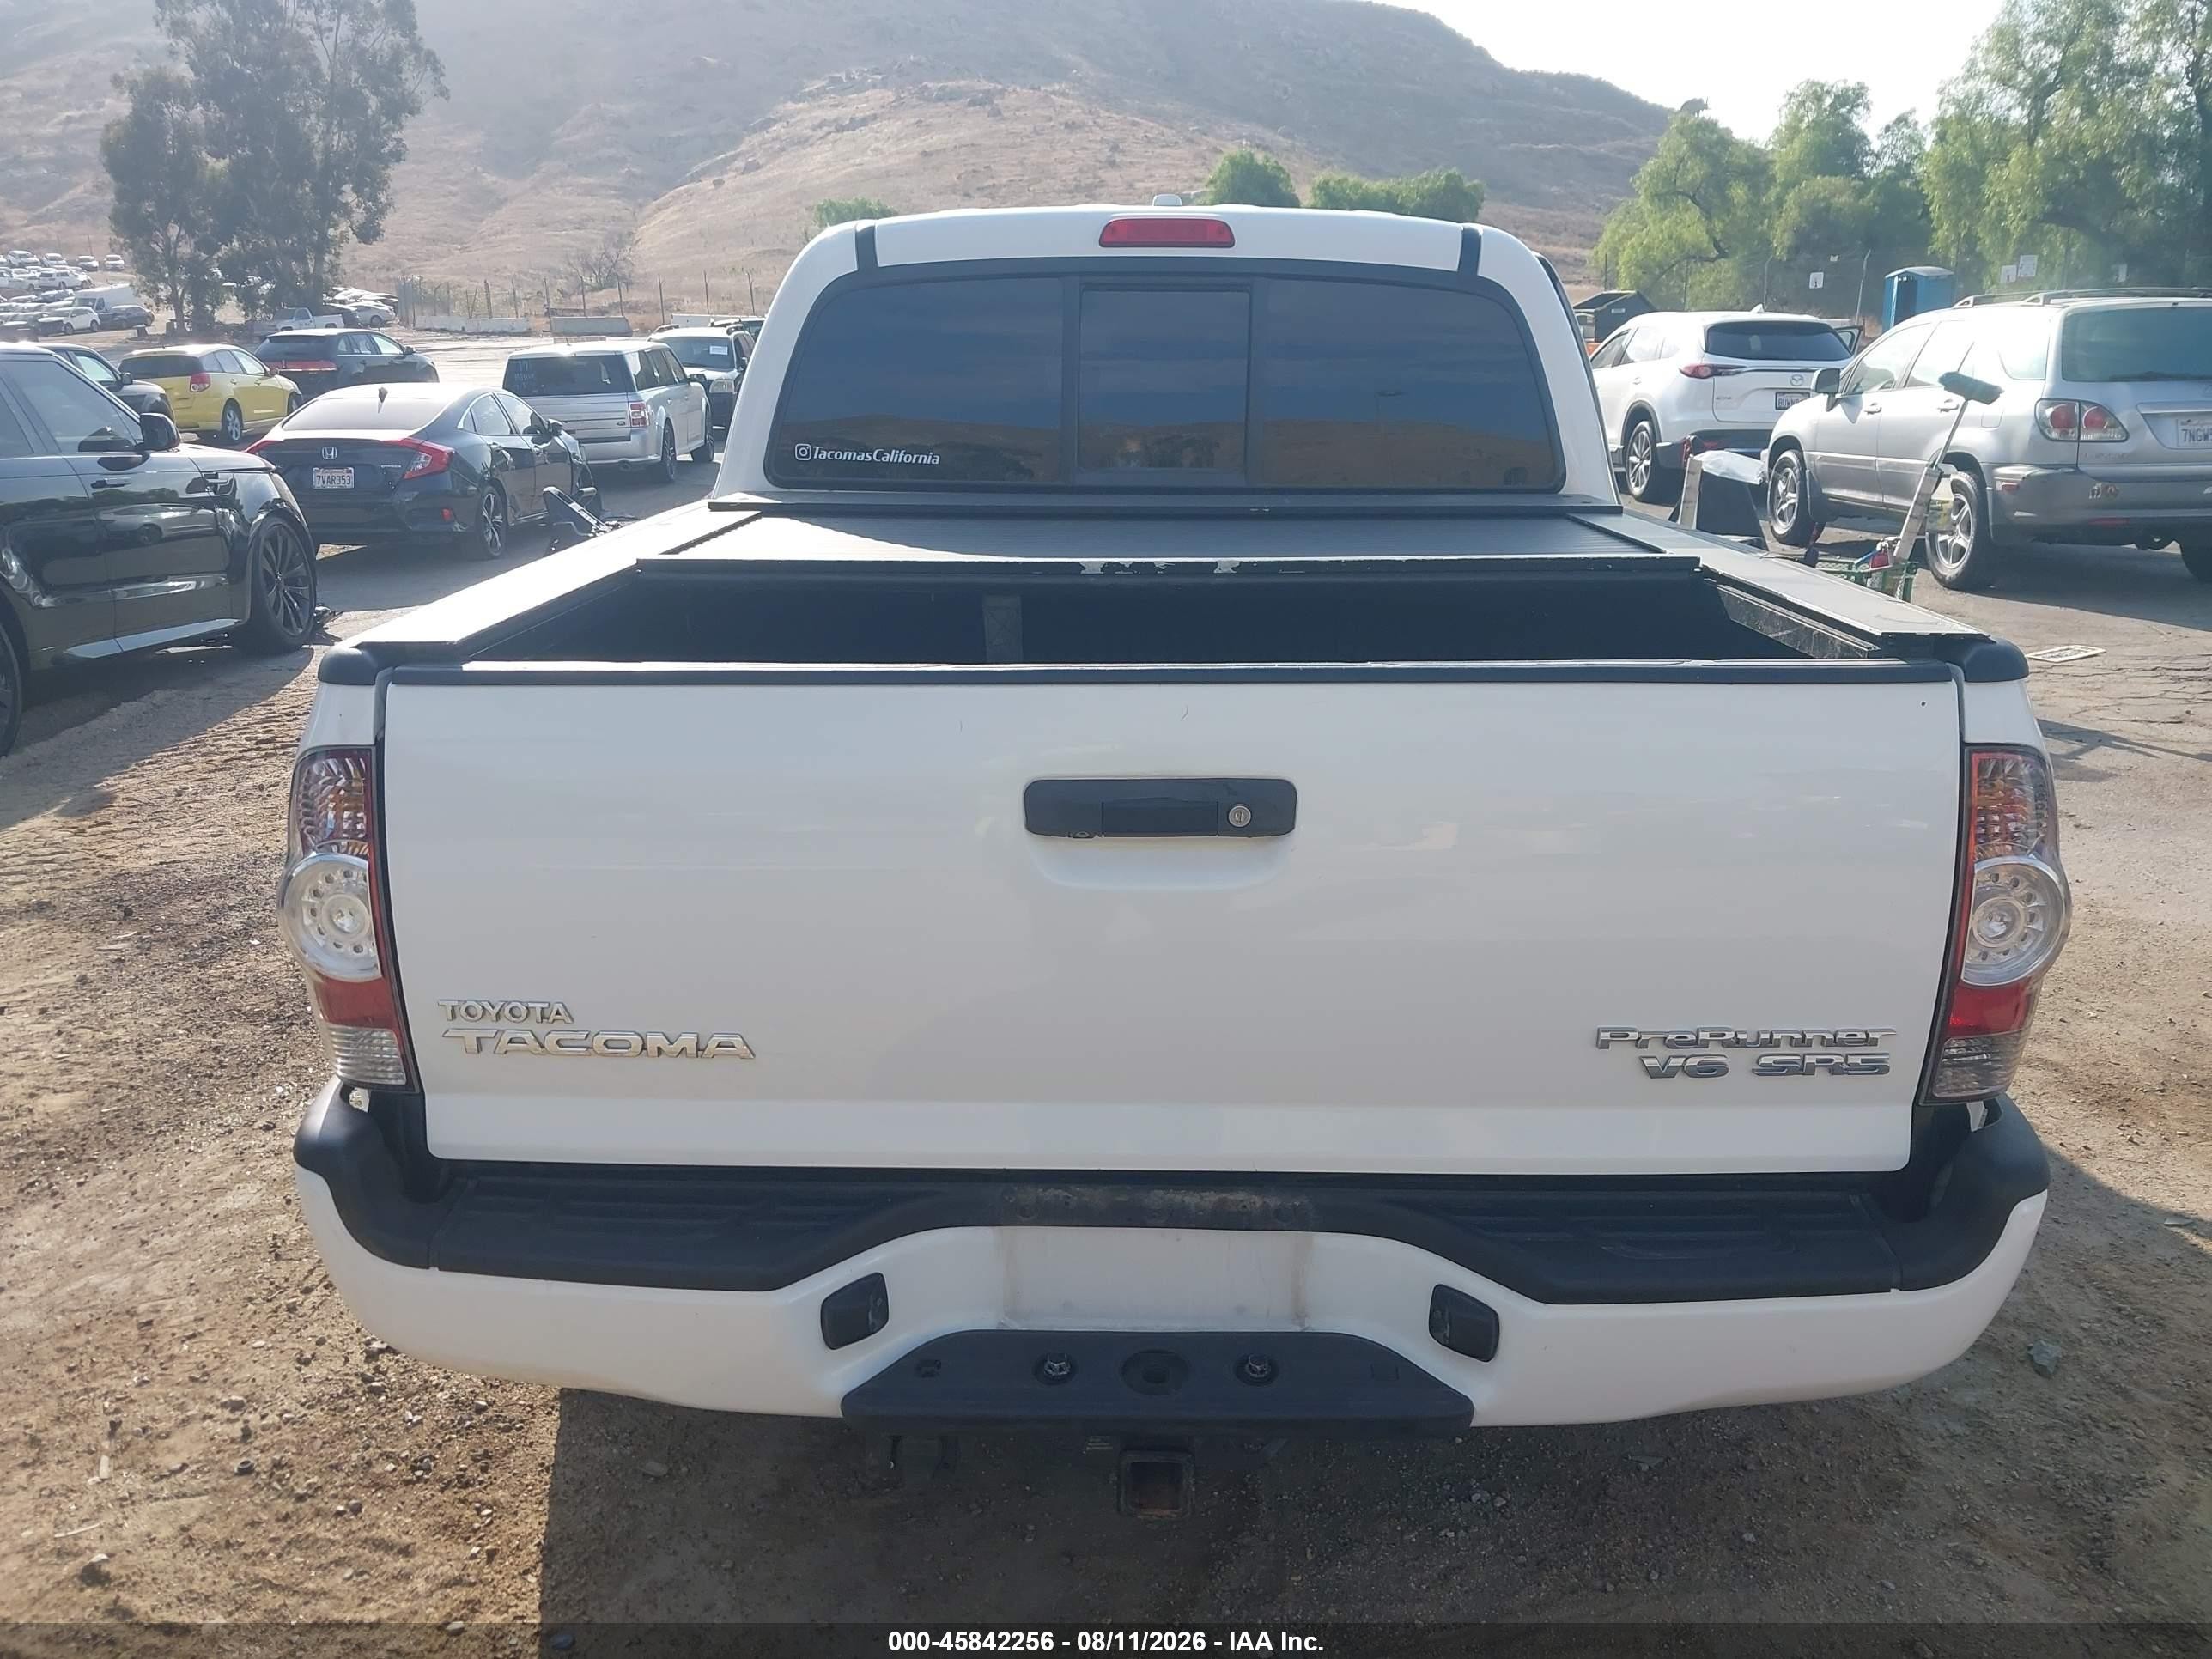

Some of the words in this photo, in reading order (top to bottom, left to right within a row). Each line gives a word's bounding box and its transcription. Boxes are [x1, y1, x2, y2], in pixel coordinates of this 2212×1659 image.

[812, 446, 940, 465] TacomasCalifornia
[316, 475, 351, 485] 7VAR353
[438, 999, 574, 1024] TOYOTA
[442, 1028, 756, 1060] TACOMA
[1596, 1026, 1897, 1049] PreRunner
[1639, 1054, 1730, 1079] V6
[1751, 1053, 1891, 1077] SR5
